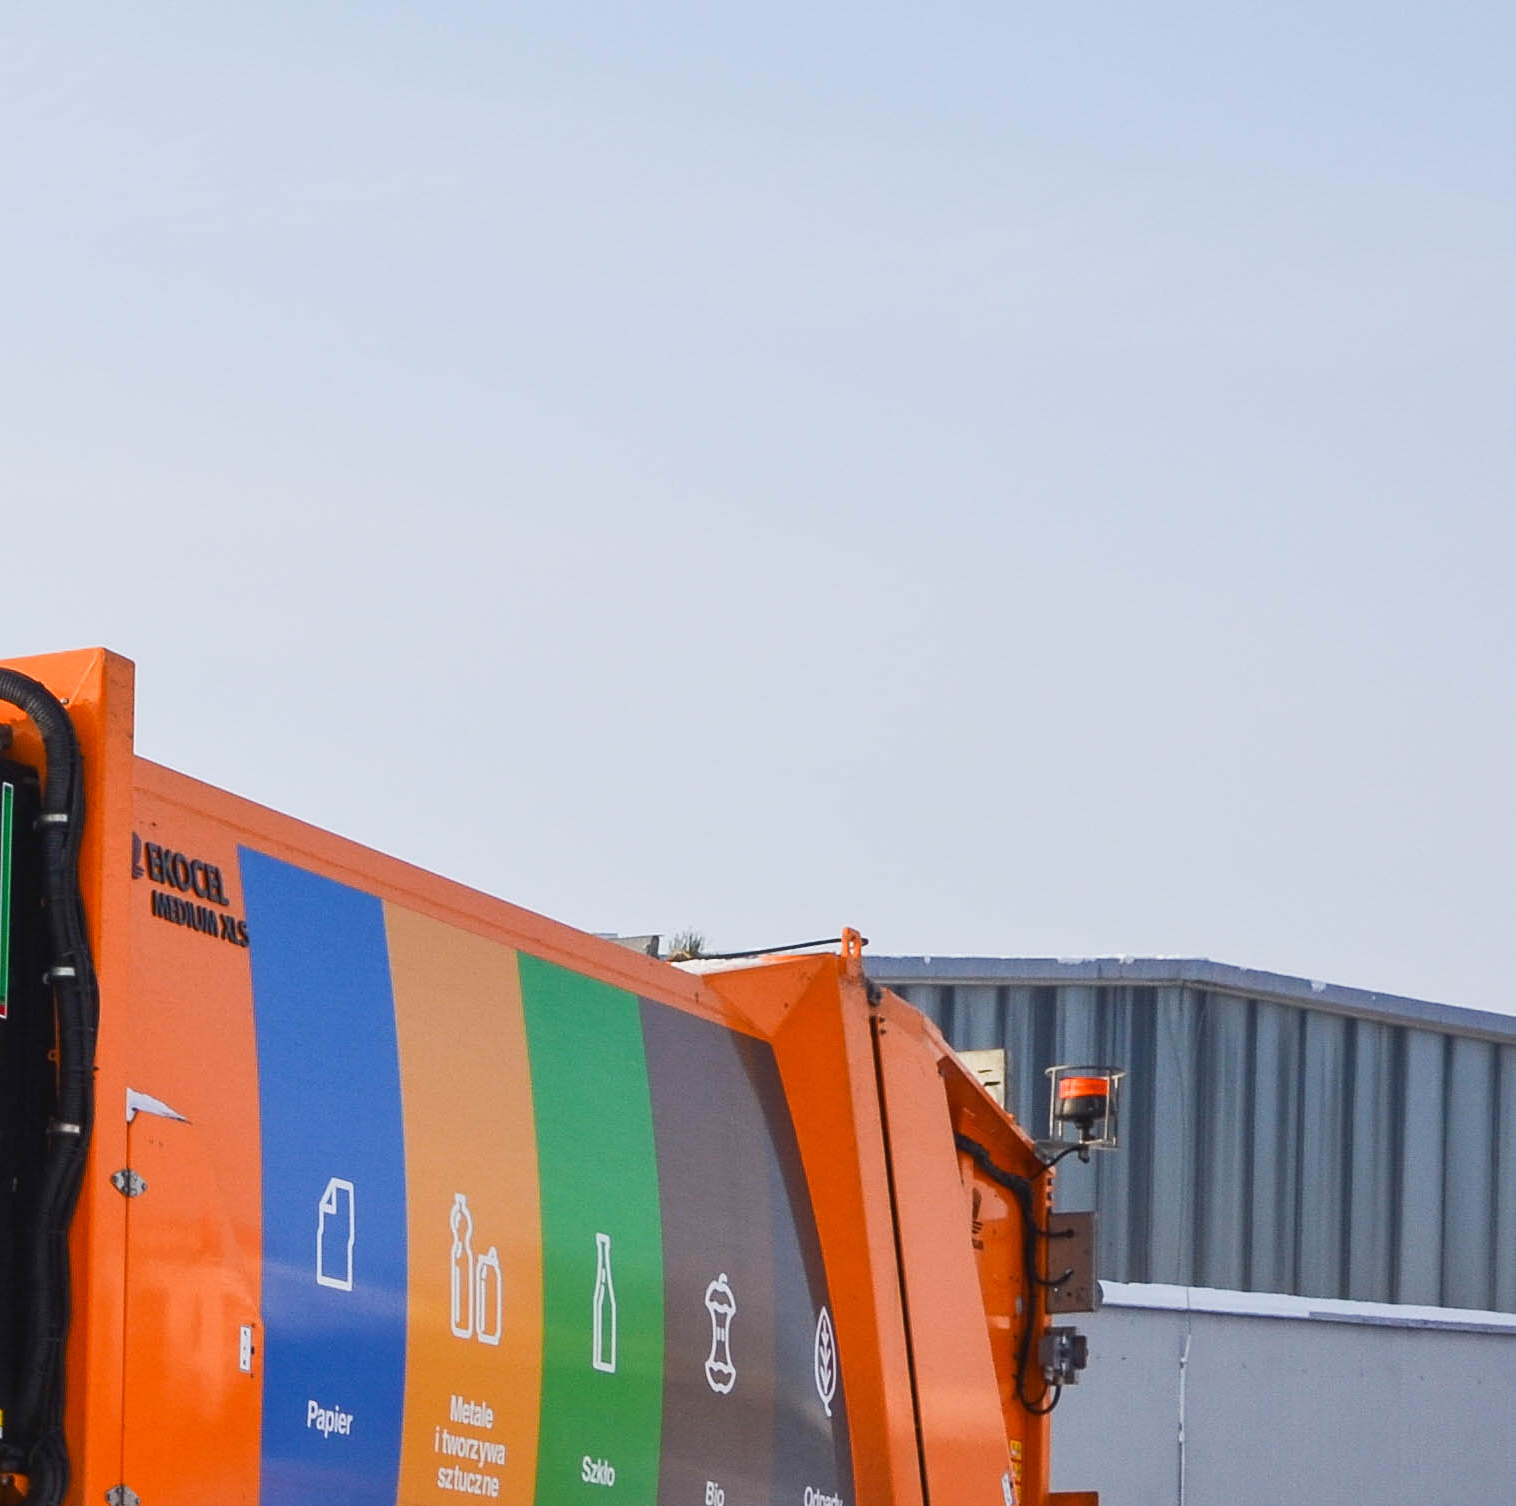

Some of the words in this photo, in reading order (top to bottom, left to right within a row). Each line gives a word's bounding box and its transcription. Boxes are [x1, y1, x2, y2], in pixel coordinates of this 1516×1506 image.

[145, 841, 230, 906] EKOCEL
[151, 889, 218, 938] MEDIUM
[219, 912, 250, 948] XLS
[306, 1399, 354, 1439] Papier
[449, 1394, 495, 1429] Metale
[434, 1426, 440, 1453] i
[442, 1428, 507, 1468] tworzywa
[436, 1465, 500, 1498] sztuczne
[581, 1455, 615, 1487] Szkło
